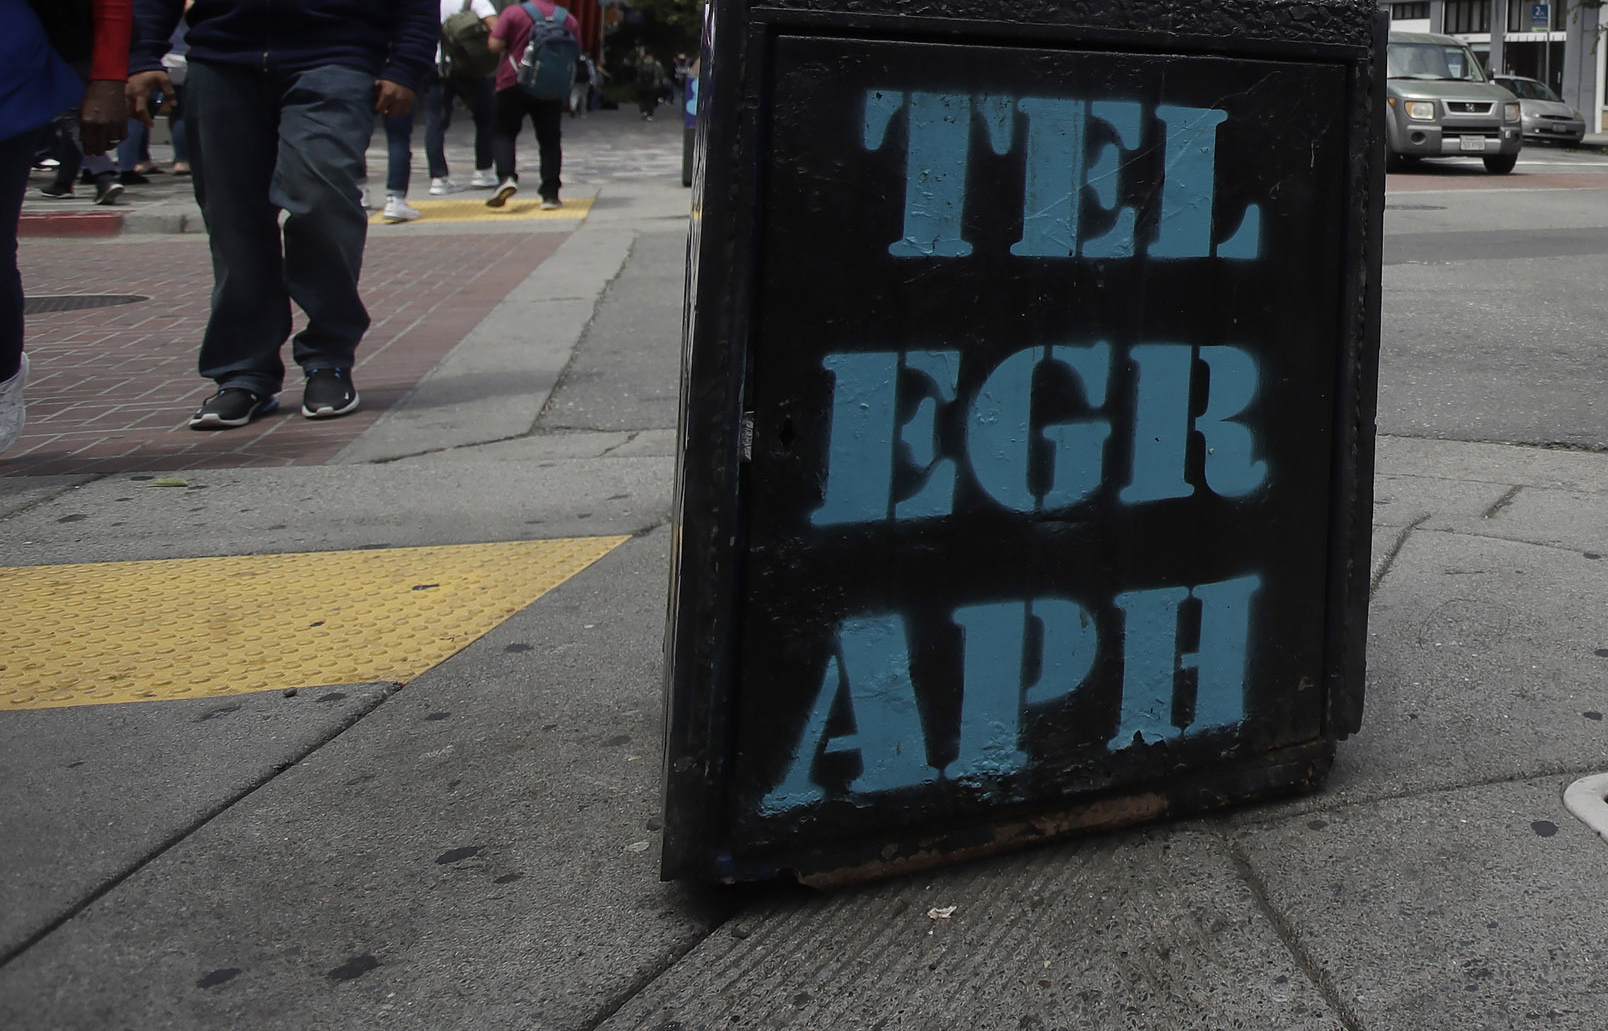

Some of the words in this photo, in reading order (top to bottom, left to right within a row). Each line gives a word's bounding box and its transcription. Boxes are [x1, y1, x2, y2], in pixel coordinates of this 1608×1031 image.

[864, 90, 1263, 260] TEL
[810, 341, 1268, 526] EGR
[758, 574, 1261, 819] APH
